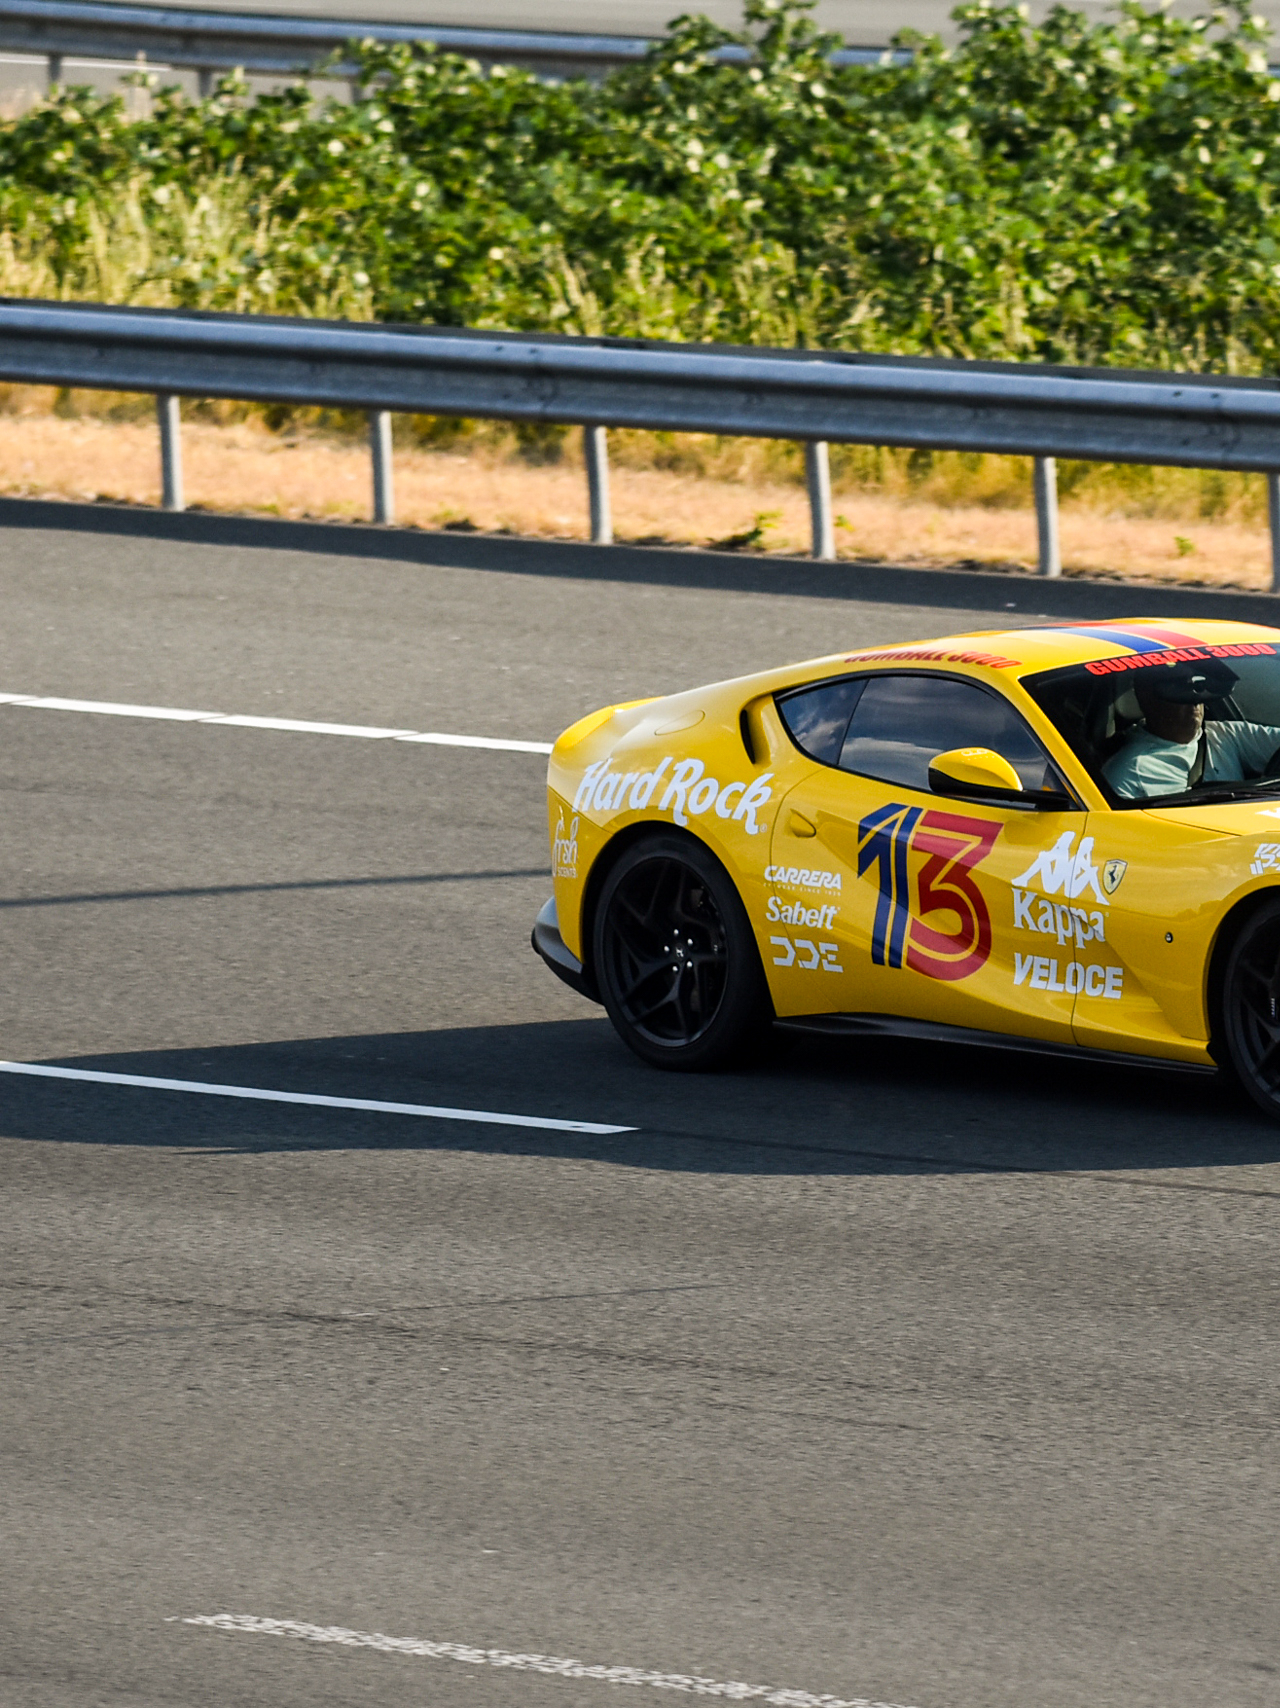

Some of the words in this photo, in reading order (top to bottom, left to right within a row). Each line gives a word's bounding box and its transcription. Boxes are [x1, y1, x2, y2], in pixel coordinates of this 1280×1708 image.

[1085, 647, 1211, 676] GUMBALL
[1205, 643, 1277, 658] 3000
[571, 757, 673, 813] Hard
[658, 758, 774, 835] Rock
[764, 865, 842, 890] CARRERA
[857, 802, 1004, 981] 13
[766, 896, 838, 930] Sabelt
[1011, 888, 1106, 949] Kappa
[1013, 952, 1124, 999] VELOCE
